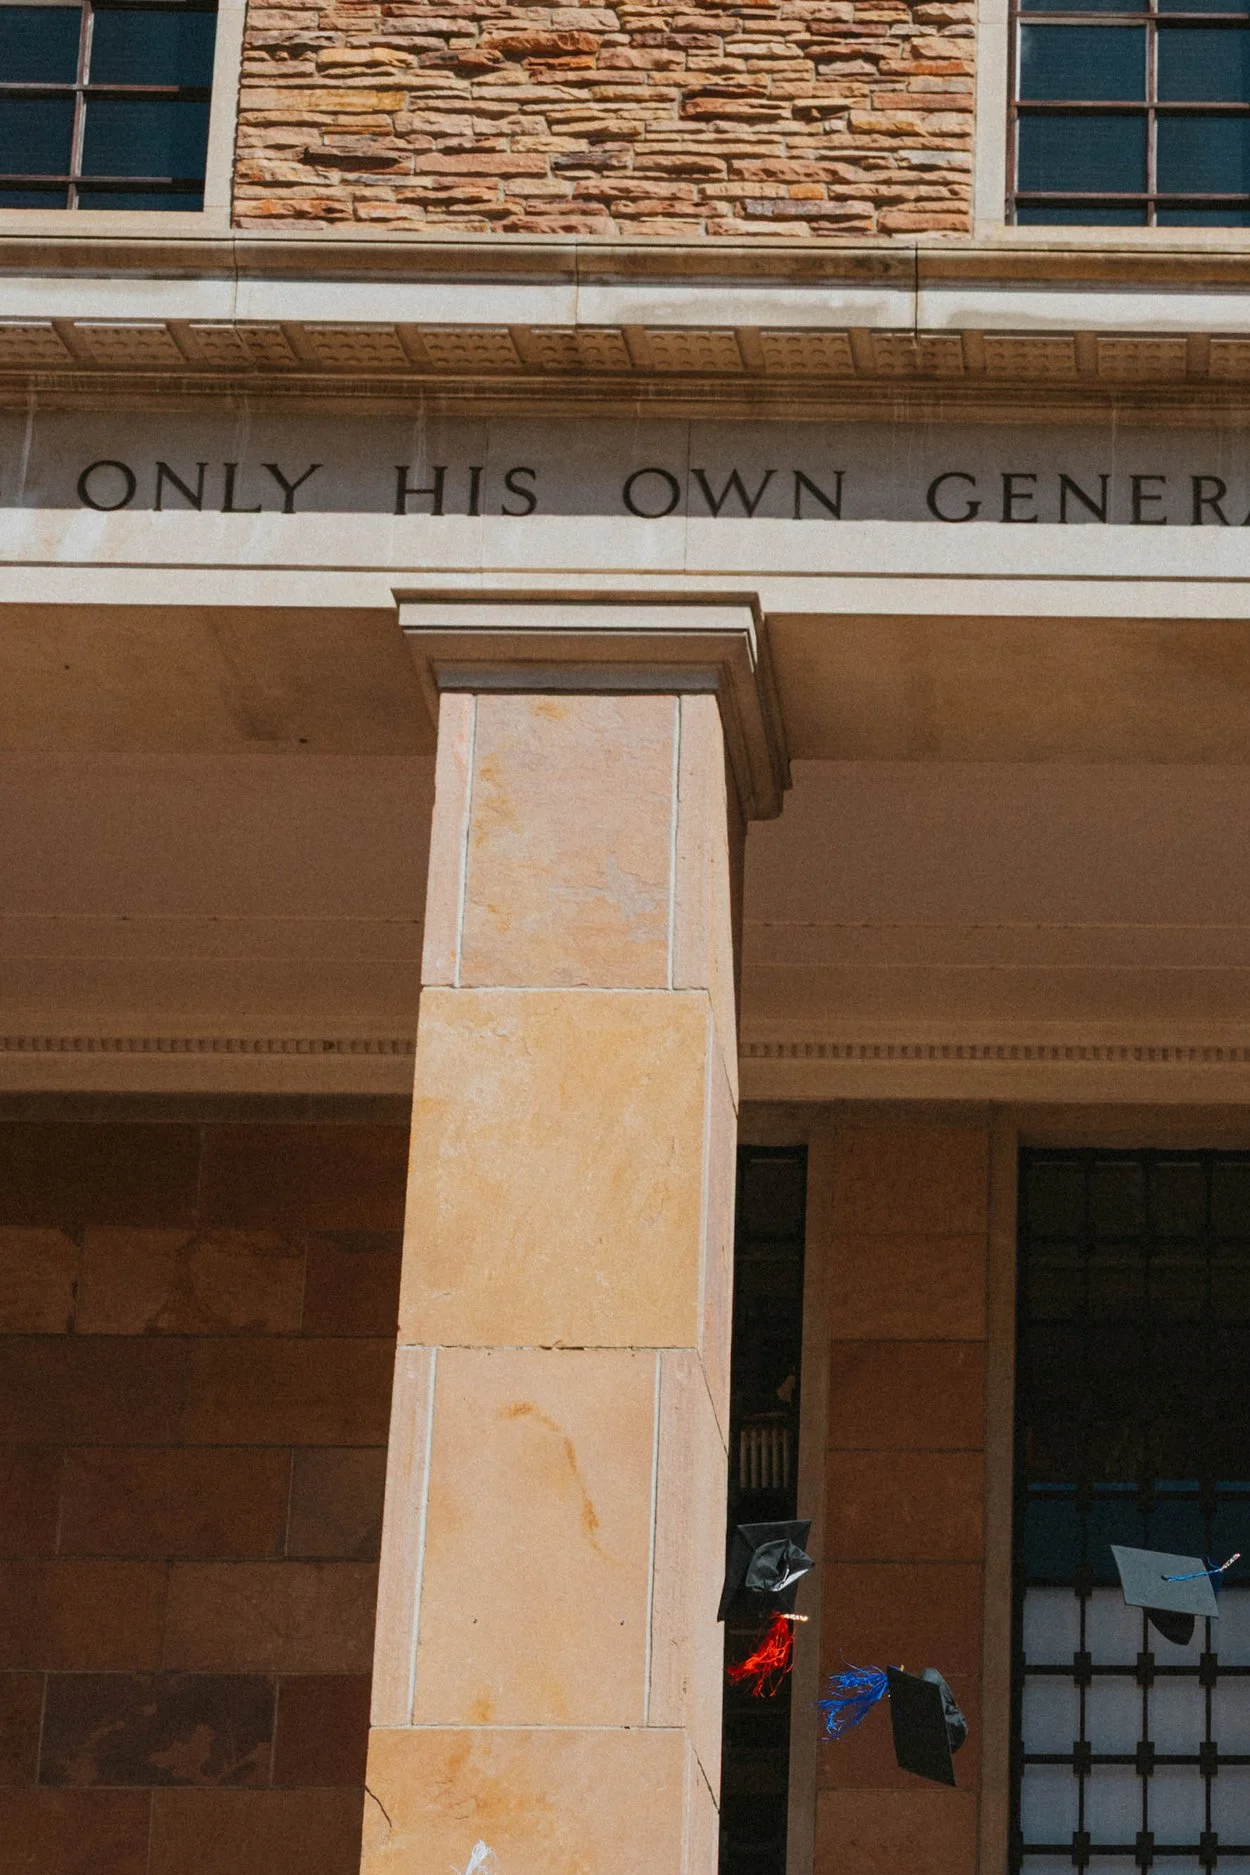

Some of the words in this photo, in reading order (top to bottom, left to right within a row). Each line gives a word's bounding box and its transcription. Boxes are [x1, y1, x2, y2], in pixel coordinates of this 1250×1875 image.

[76, 459, 324, 513] ONLY
[394, 465, 538, 516] HIS
[622, 466, 847, 520] OWN
